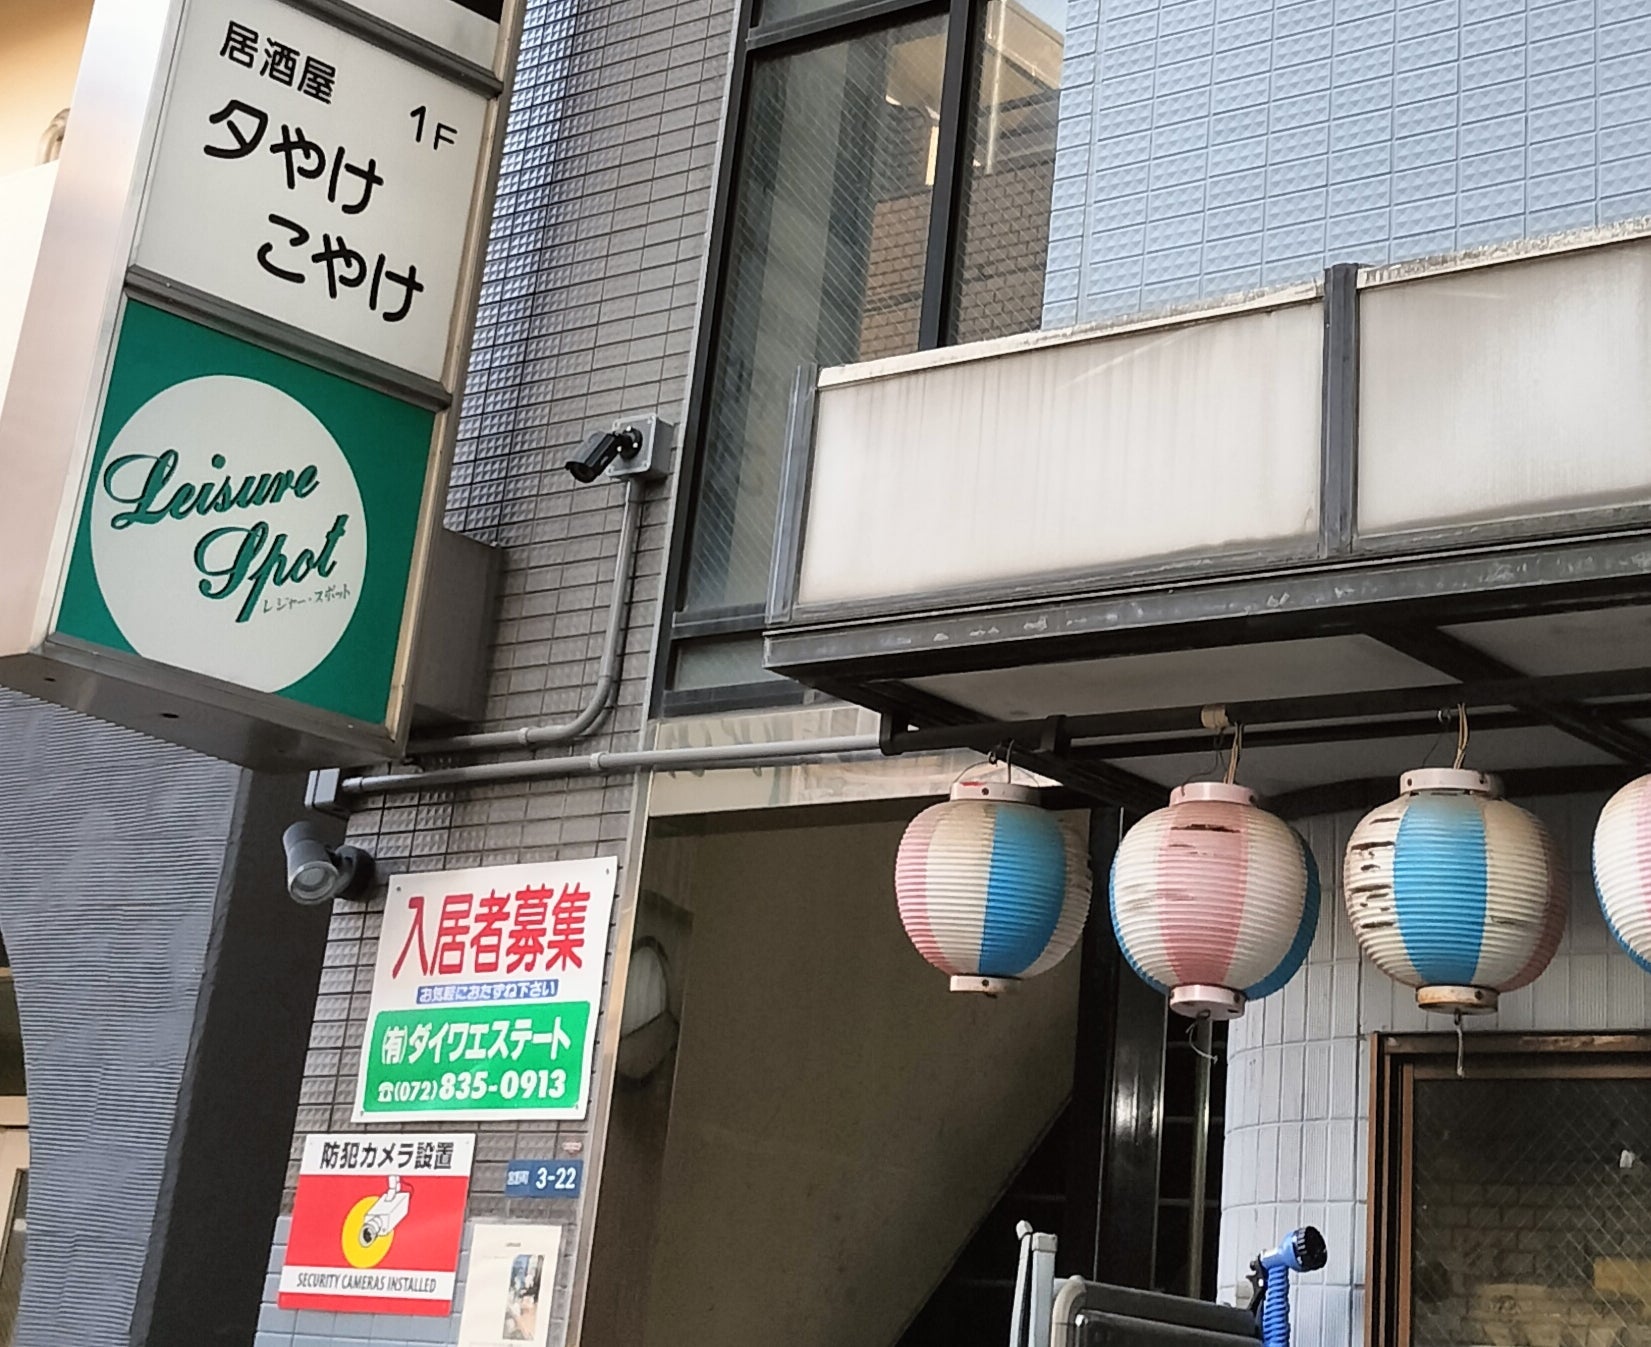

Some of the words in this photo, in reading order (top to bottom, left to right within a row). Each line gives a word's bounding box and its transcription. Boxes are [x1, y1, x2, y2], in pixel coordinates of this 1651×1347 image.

[220, 20, 336, 105] 居酒屋
[203, 99, 384, 215] 夕やけ
[410, 105, 458, 150] 1F
[257, 213, 424, 323] こやけ
[103, 448, 320, 530] Leisure
[193, 513, 350, 623] Spot
[392, 882, 591, 979] 入居者募集
[320, 1141, 454, 1170] 防犯カメラ設置
[536, 1167, 577, 1189] 3-22
[297, 1273, 340, 1289] SECURITY
[341, 1275, 385, 1291] CAMERAS
[387, 1277, 437, 1293] INSTALLED
